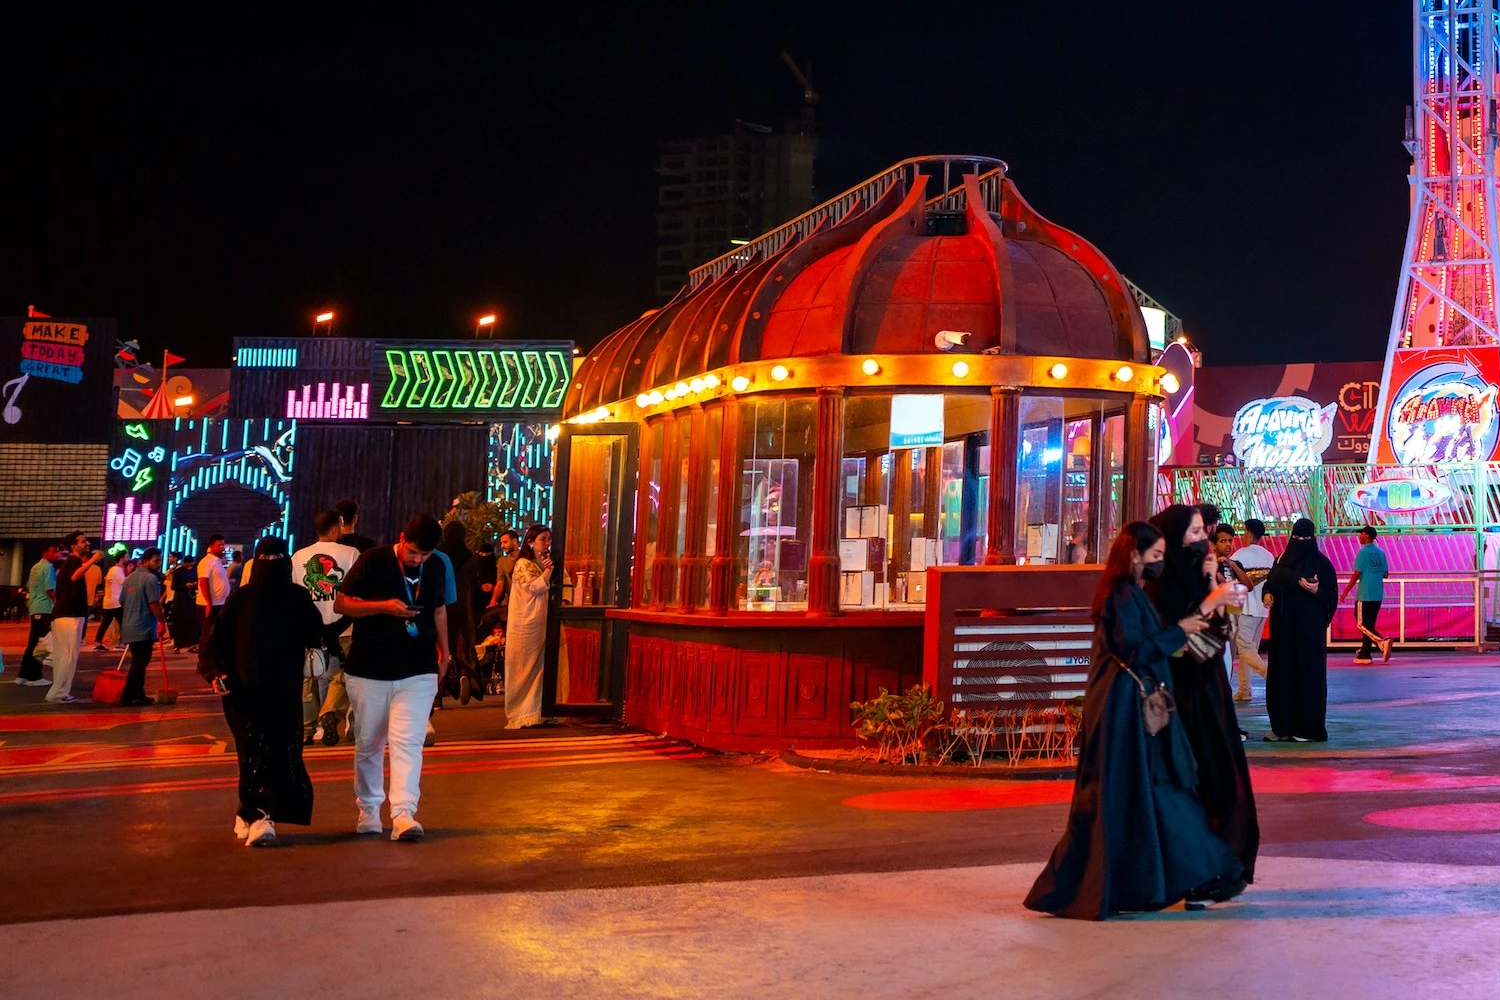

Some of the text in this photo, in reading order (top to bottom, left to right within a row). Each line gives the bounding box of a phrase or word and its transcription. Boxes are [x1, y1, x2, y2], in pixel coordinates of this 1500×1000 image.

[31, 324, 80, 340] MAKE
[29, 343, 77, 362] TODAY
[26, 361, 70, 377] GREAT
[1237, 404, 1322, 438] Around
[1387, 482, 1411, 509] 60
[1073, 656, 1090, 665] YOR
